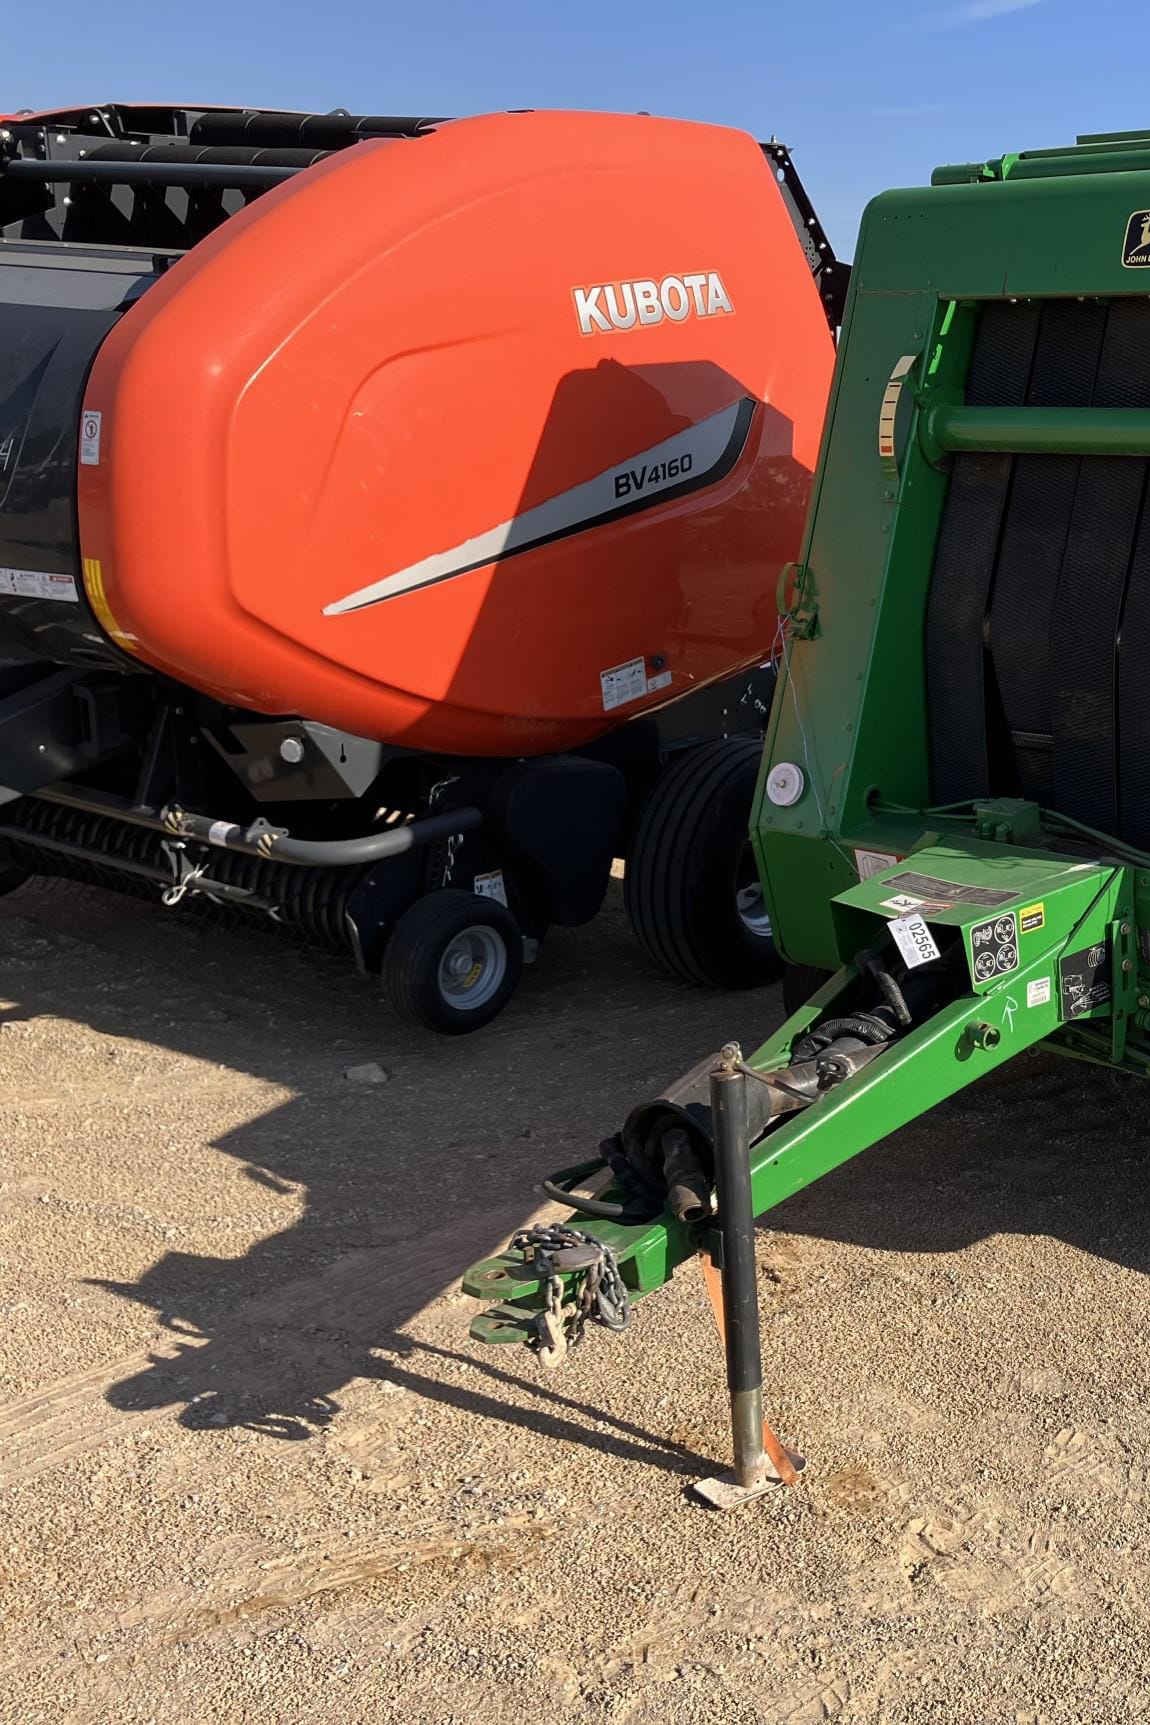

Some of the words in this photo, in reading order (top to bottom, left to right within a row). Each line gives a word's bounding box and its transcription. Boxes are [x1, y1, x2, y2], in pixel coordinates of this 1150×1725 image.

[1126, 255, 1147, 264] JOHN
[573, 272, 733, 334] KUBOTA
[614, 453, 693, 499] BV4160
[908, 922, 936, 960] 02565
[1001, 996, 1018, 1032] R
